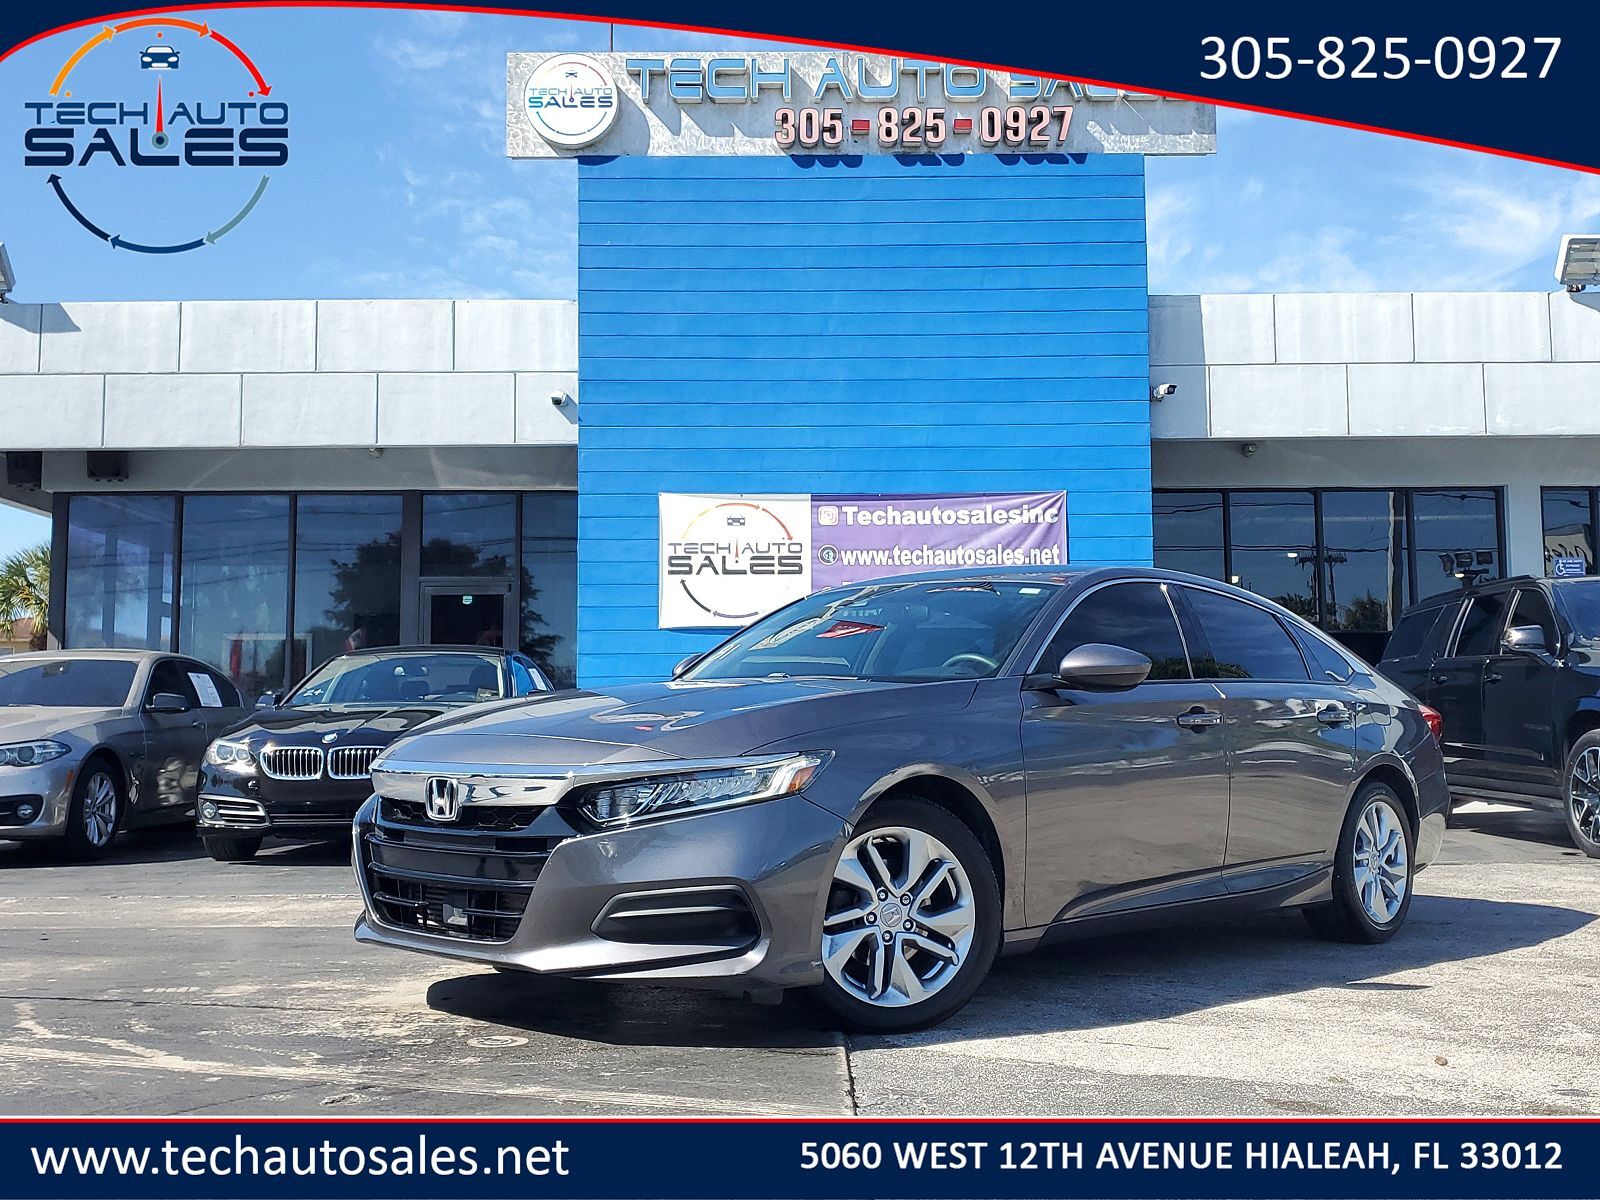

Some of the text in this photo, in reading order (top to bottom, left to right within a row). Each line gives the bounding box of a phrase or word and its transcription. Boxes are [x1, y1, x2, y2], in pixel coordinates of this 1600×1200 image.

[626, 58, 792, 102] TECH
[814, 57, 986, 102] AUTO
[528, 95, 613, 108] SALES
[529, 87, 612, 96] TECH AUTO
[774, 107, 1074, 149] 305-825-0927
[841, 504, 1059, 526] Techautosalesinc
[667, 542, 803, 555] TECH AUTO
[840, 543, 1061, 566] www.techautosales.net
[667, 555, 804, 576] SALES
